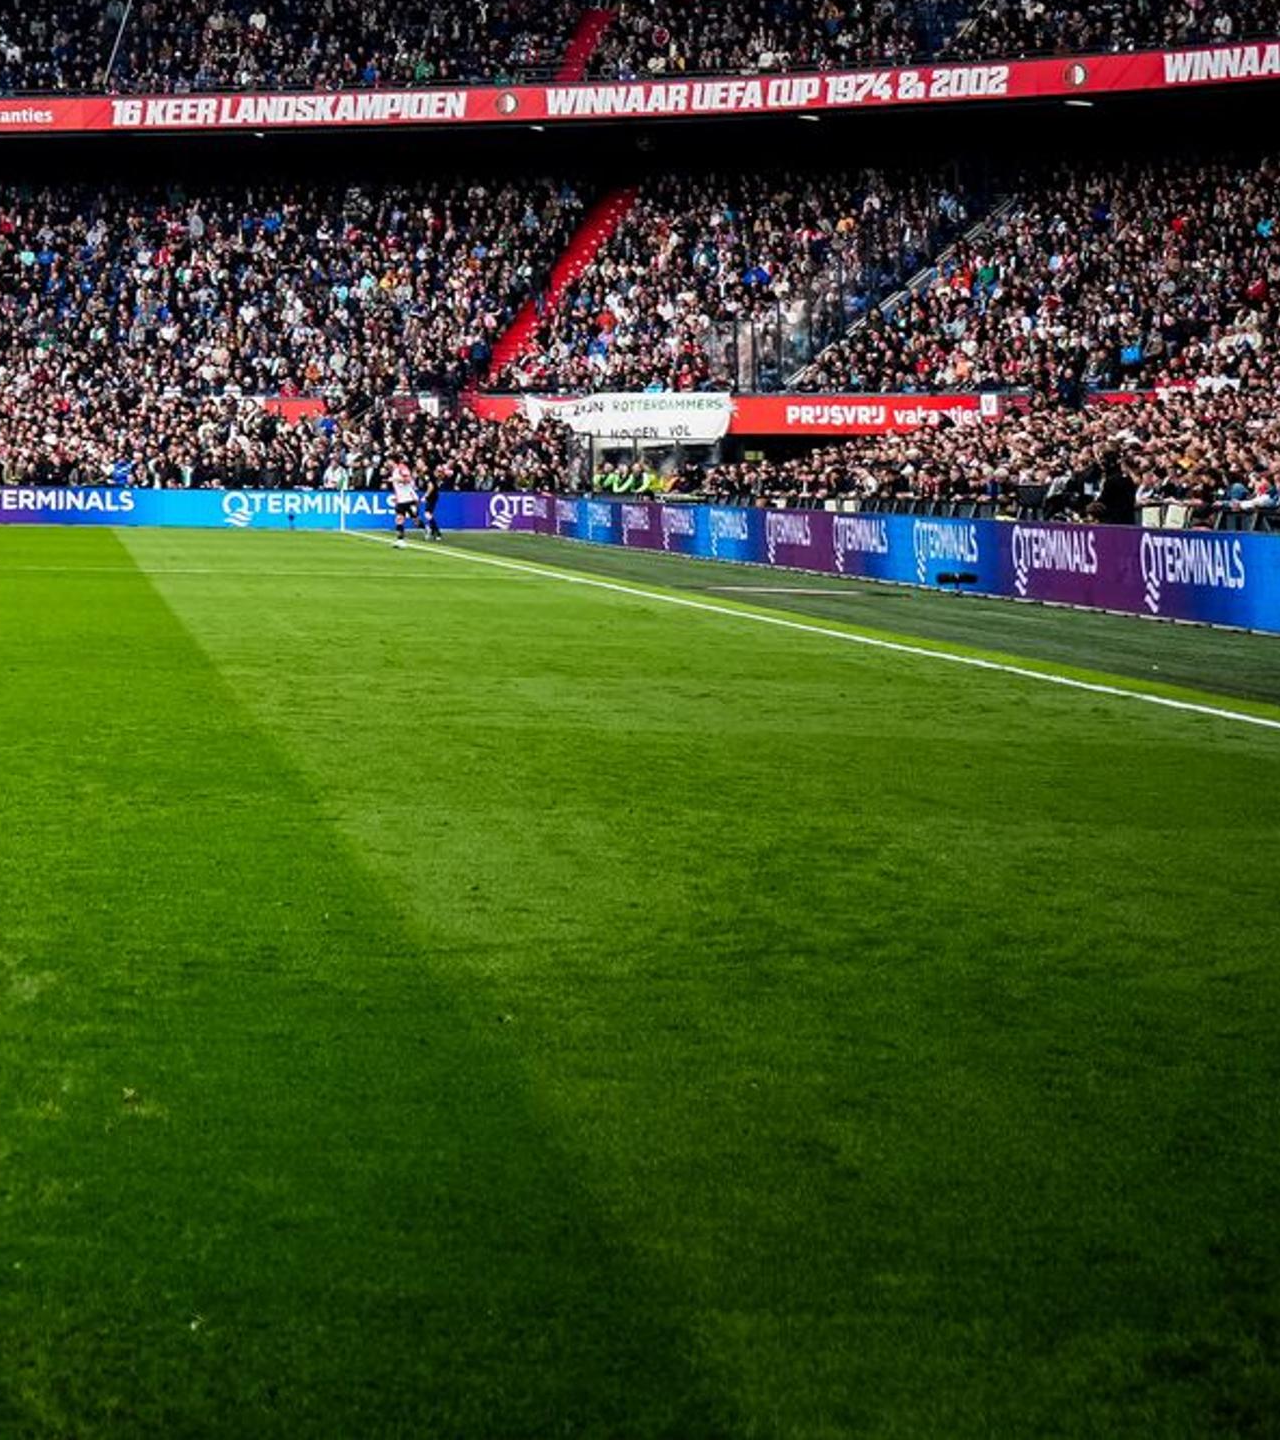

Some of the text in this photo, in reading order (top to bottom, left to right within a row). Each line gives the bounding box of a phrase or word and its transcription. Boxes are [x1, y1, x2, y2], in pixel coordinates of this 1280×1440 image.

[111, 92, 467, 126] 16 KEER LANDSKAMPIOEN
[546, 66, 1009, 115] WINNAAR UEFA CUP 1974 & 2002
[894, 407, 981, 427] vakaties
[1012, 524, 1098, 596] QTERMINALS
[1140, 532, 1245, 613] QTERMINALS
